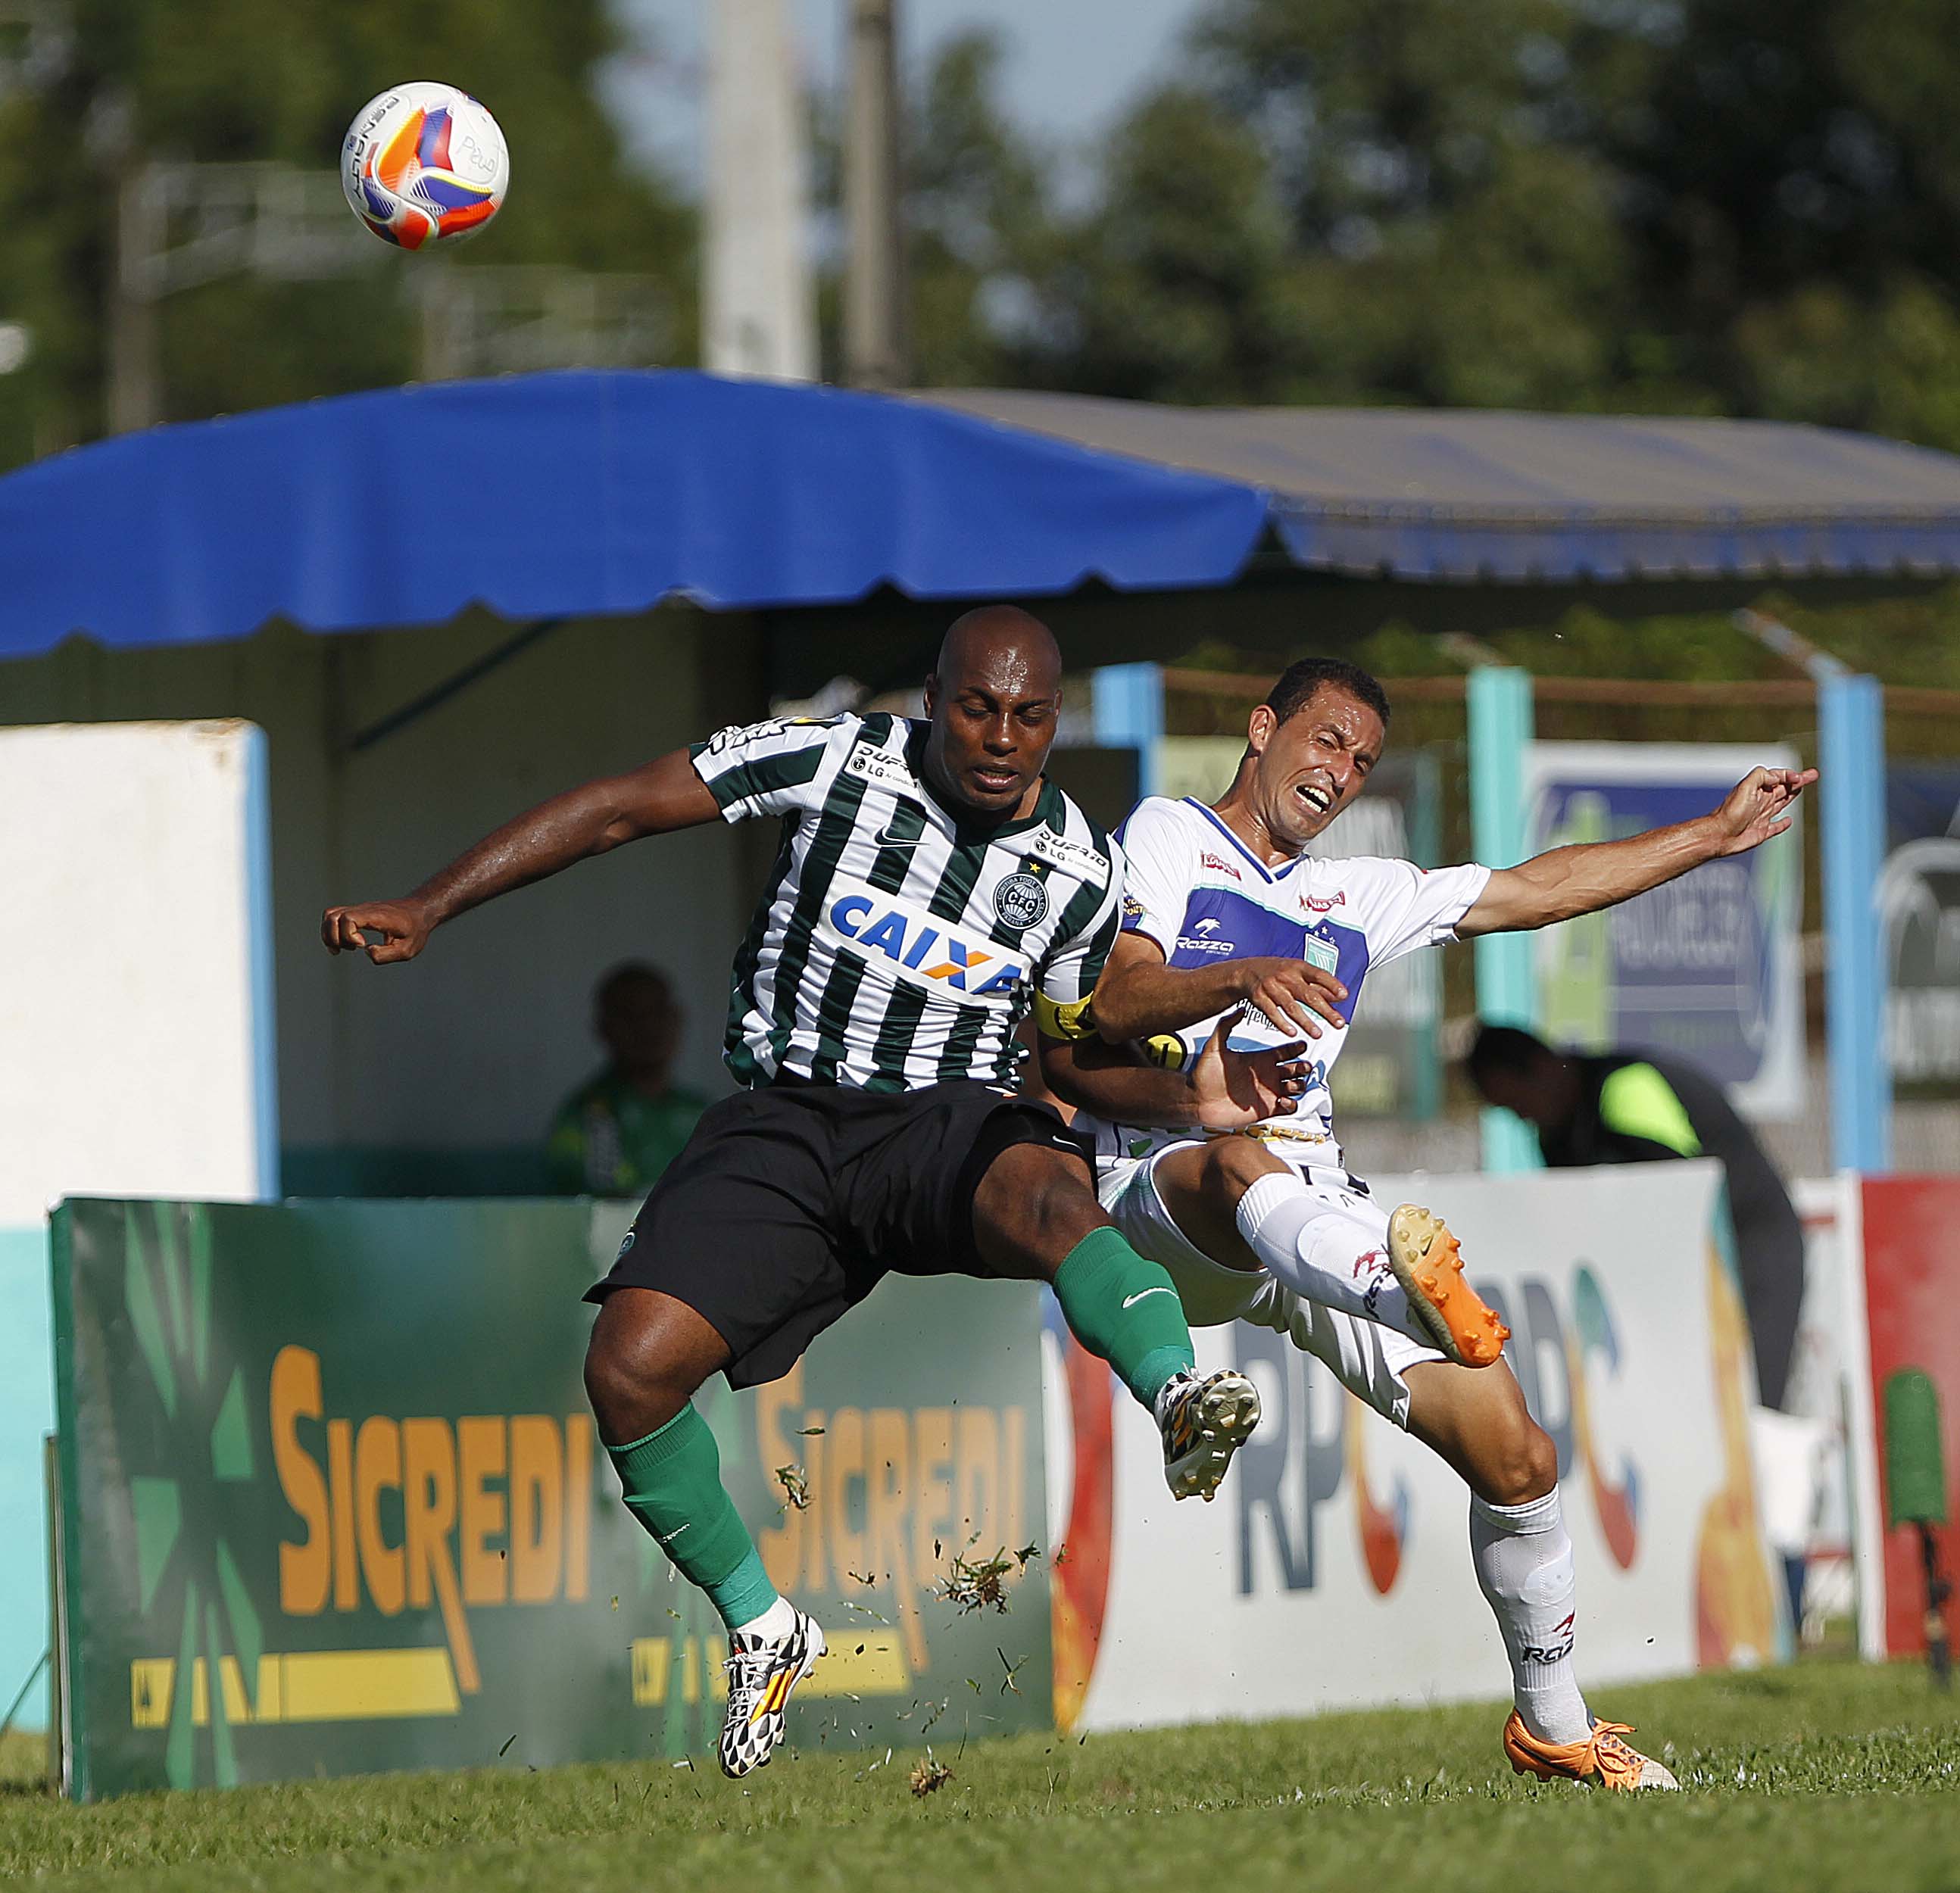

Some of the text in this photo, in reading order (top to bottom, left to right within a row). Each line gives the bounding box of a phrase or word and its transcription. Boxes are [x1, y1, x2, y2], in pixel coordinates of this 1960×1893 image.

[867, 764, 885, 778] LG
[1050, 848, 1066, 862] LG
[1008, 891, 1035, 912] CFC
[829, 894, 1024, 995] CAIXA
